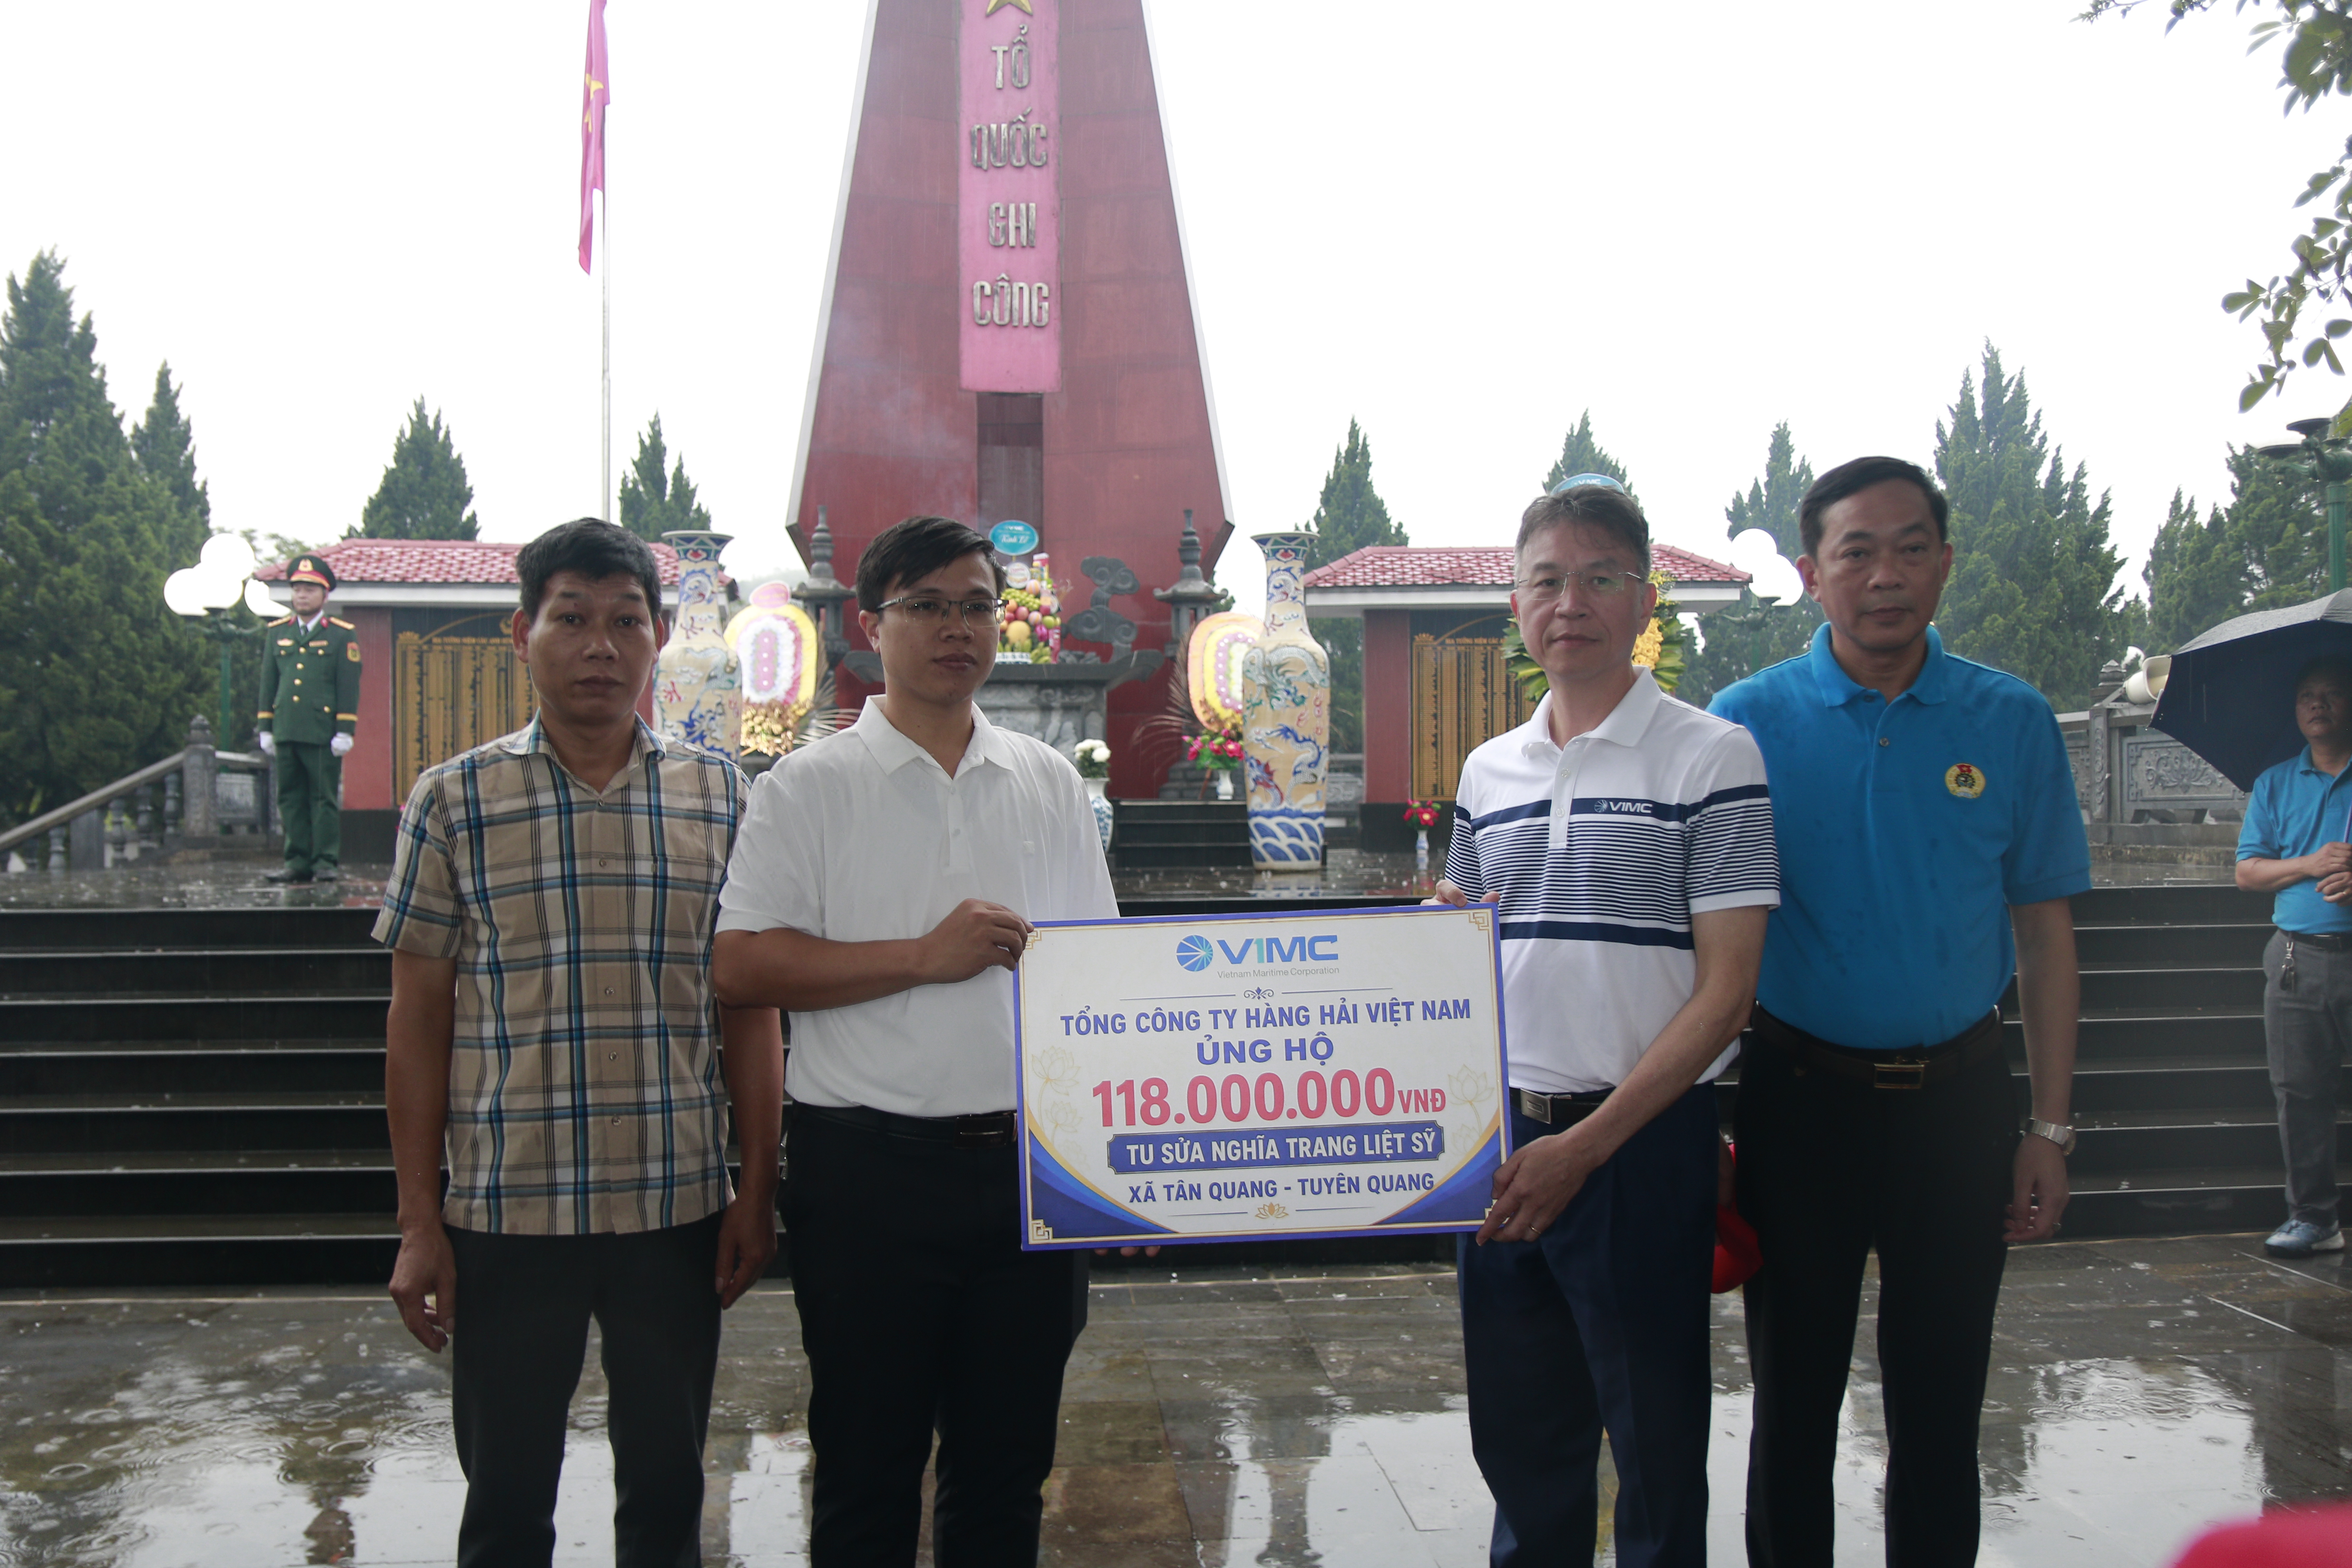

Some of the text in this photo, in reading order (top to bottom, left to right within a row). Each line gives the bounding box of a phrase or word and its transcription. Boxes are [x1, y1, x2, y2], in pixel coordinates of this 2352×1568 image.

[991, 24, 1030, 89] TỔ
[970, 107, 1047, 171] QUỐC
[988, 202, 1036, 247] GHI
[973, 273, 1050, 327] CÔNG
[1609, 801, 1653, 813] VIMC
[1216, 935, 1339, 965] VIMC
[1217, 966, 1339, 978] Vietnam Maritime Corporation
[1061, 997, 1470, 1035] TỔNG CÔNG TY HÀNG HẢI VIỆT NAM
[1198, 1032, 1333, 1065] ỦNG HỘ
[1093, 1068, 1446, 1127] 118.000.000 VNĐ
[1127, 1127, 1436, 1165] TU SỬA NGHĨA TRANG LIỆT SỸ
[1130, 1181, 1156, 1202] XÃ
[1163, 1180, 1201, 1201] TÂN
[1210, 1180, 1277, 1201] QUANG
[1298, 1173, 1359, 1195] TUYÊN
[1368, 1173, 1434, 1193] QUANG
